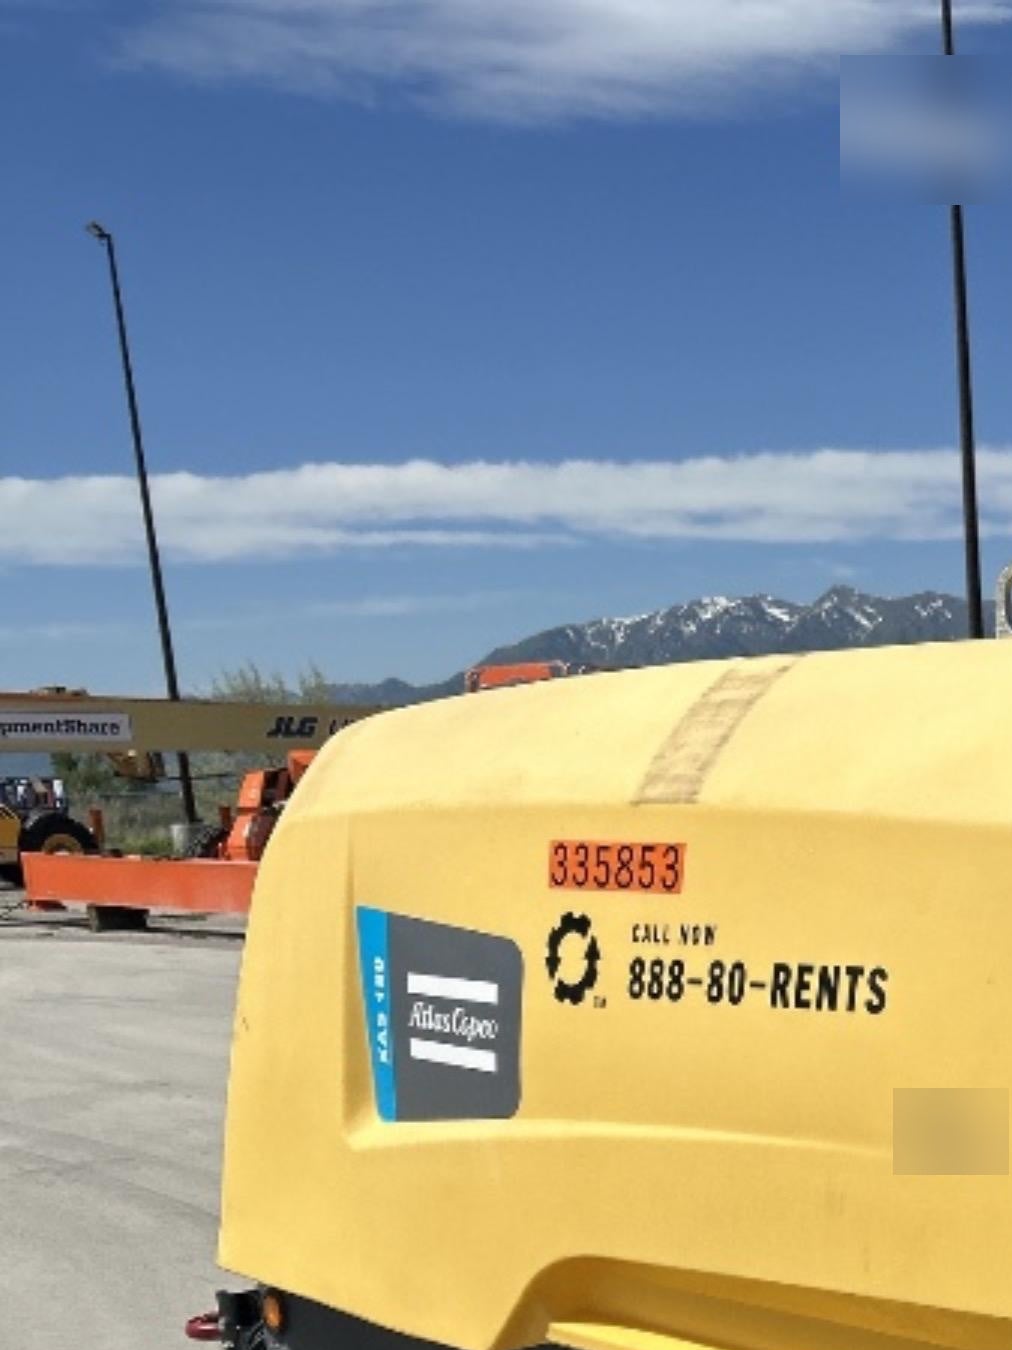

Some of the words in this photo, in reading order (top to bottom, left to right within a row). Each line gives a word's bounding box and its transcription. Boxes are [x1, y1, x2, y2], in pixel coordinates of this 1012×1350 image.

[266, 716, 318, 738] JLG
[551, 842, 680, 890] 335853
[631, 923, 670, 944] CALL
[679, 924, 717, 946] NOW
[628, 956, 889, 1015] 888-80-RENTS
[408, 1001, 451, 1034] Atlas
[452, 1007, 499, 1042] Copco
